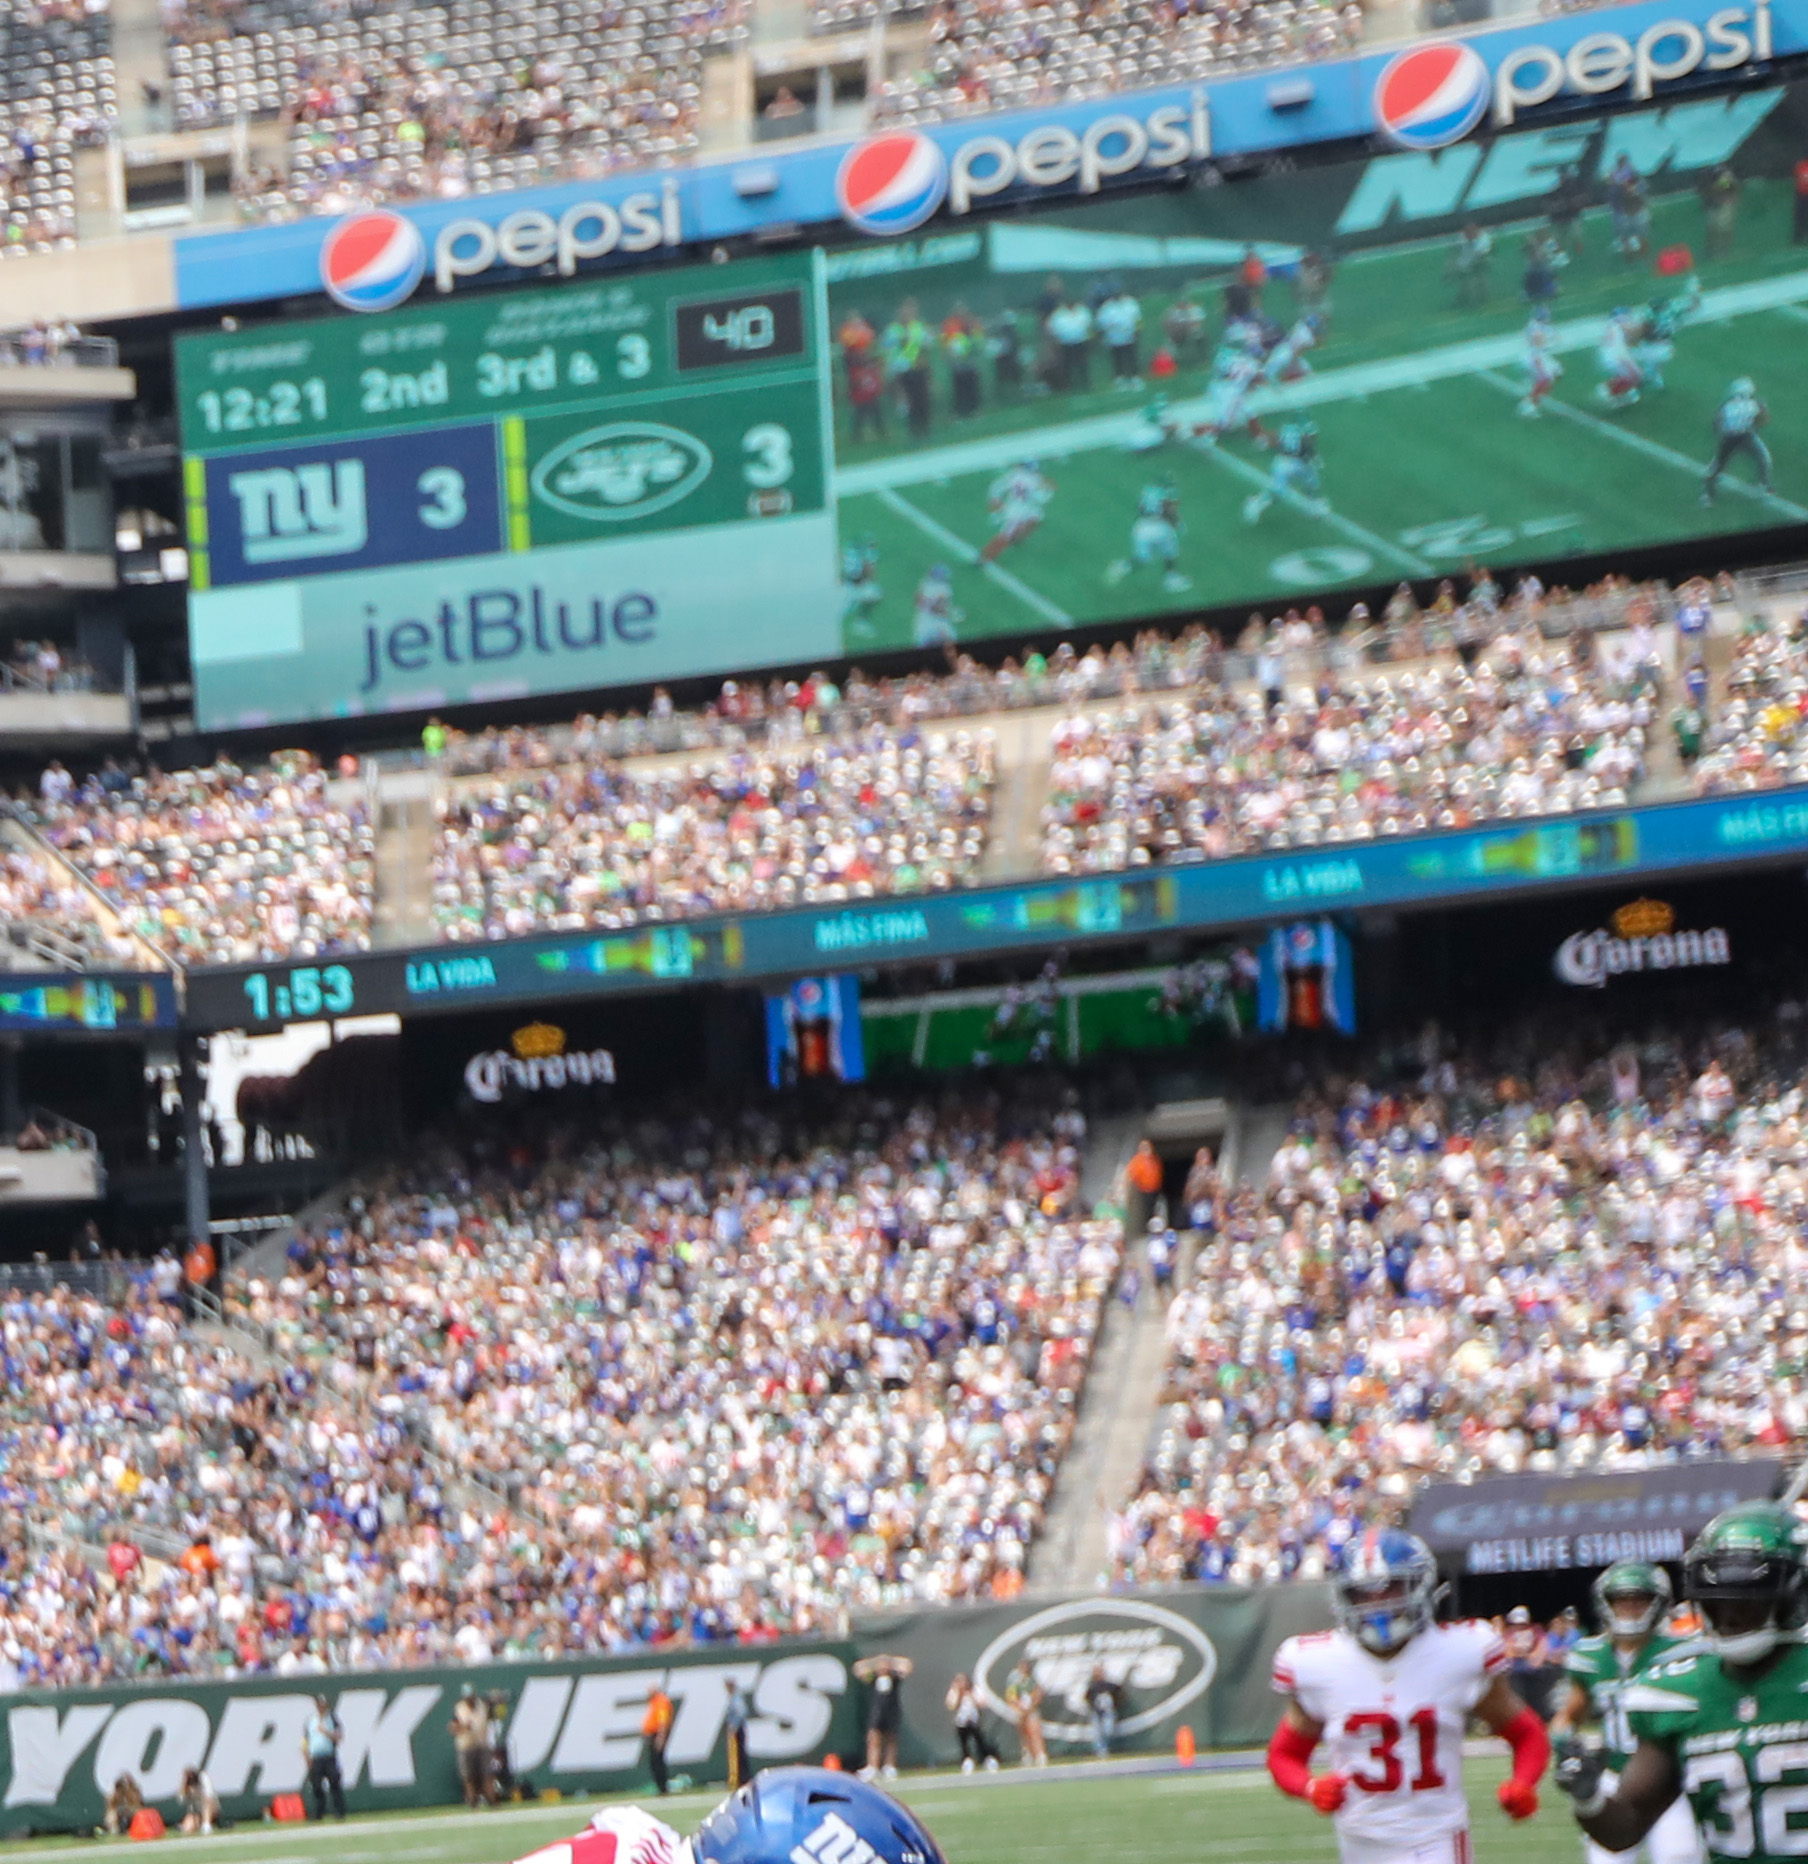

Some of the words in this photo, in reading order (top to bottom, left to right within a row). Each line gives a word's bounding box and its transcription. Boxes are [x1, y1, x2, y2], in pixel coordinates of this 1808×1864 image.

[1494, 0, 1773, 128] pepsi
[950, 88, 1210, 213] pepsi
[1334, 86, 1787, 236] NEW
[434, 177, 682, 293] pepsi
[703, 305, 775, 351] 40
[360, 360, 449, 413] 2nd
[476, 346, 557, 397] 3rd
[617, 334, 651, 379] 3
[196, 378, 327, 432] 12:21
[742, 424, 794, 487] 3
[417, 465, 468, 530] 3
[359, 585, 658, 692] jetBlue
[405, 959, 436, 995] LA
[439, 955, 496, 990] VIDA
[1553, 927, 1731, 989] Corona
[242, 964, 355, 1021] 1:53
[1467, 1535, 1570, 1574] METLIFE
[1575, 1527, 1684, 1566] STADIUM
[3, 1681, 444, 1808] YORK
[502, 1653, 846, 1772] JETS
[1344, 1707, 1445, 1794] 31
